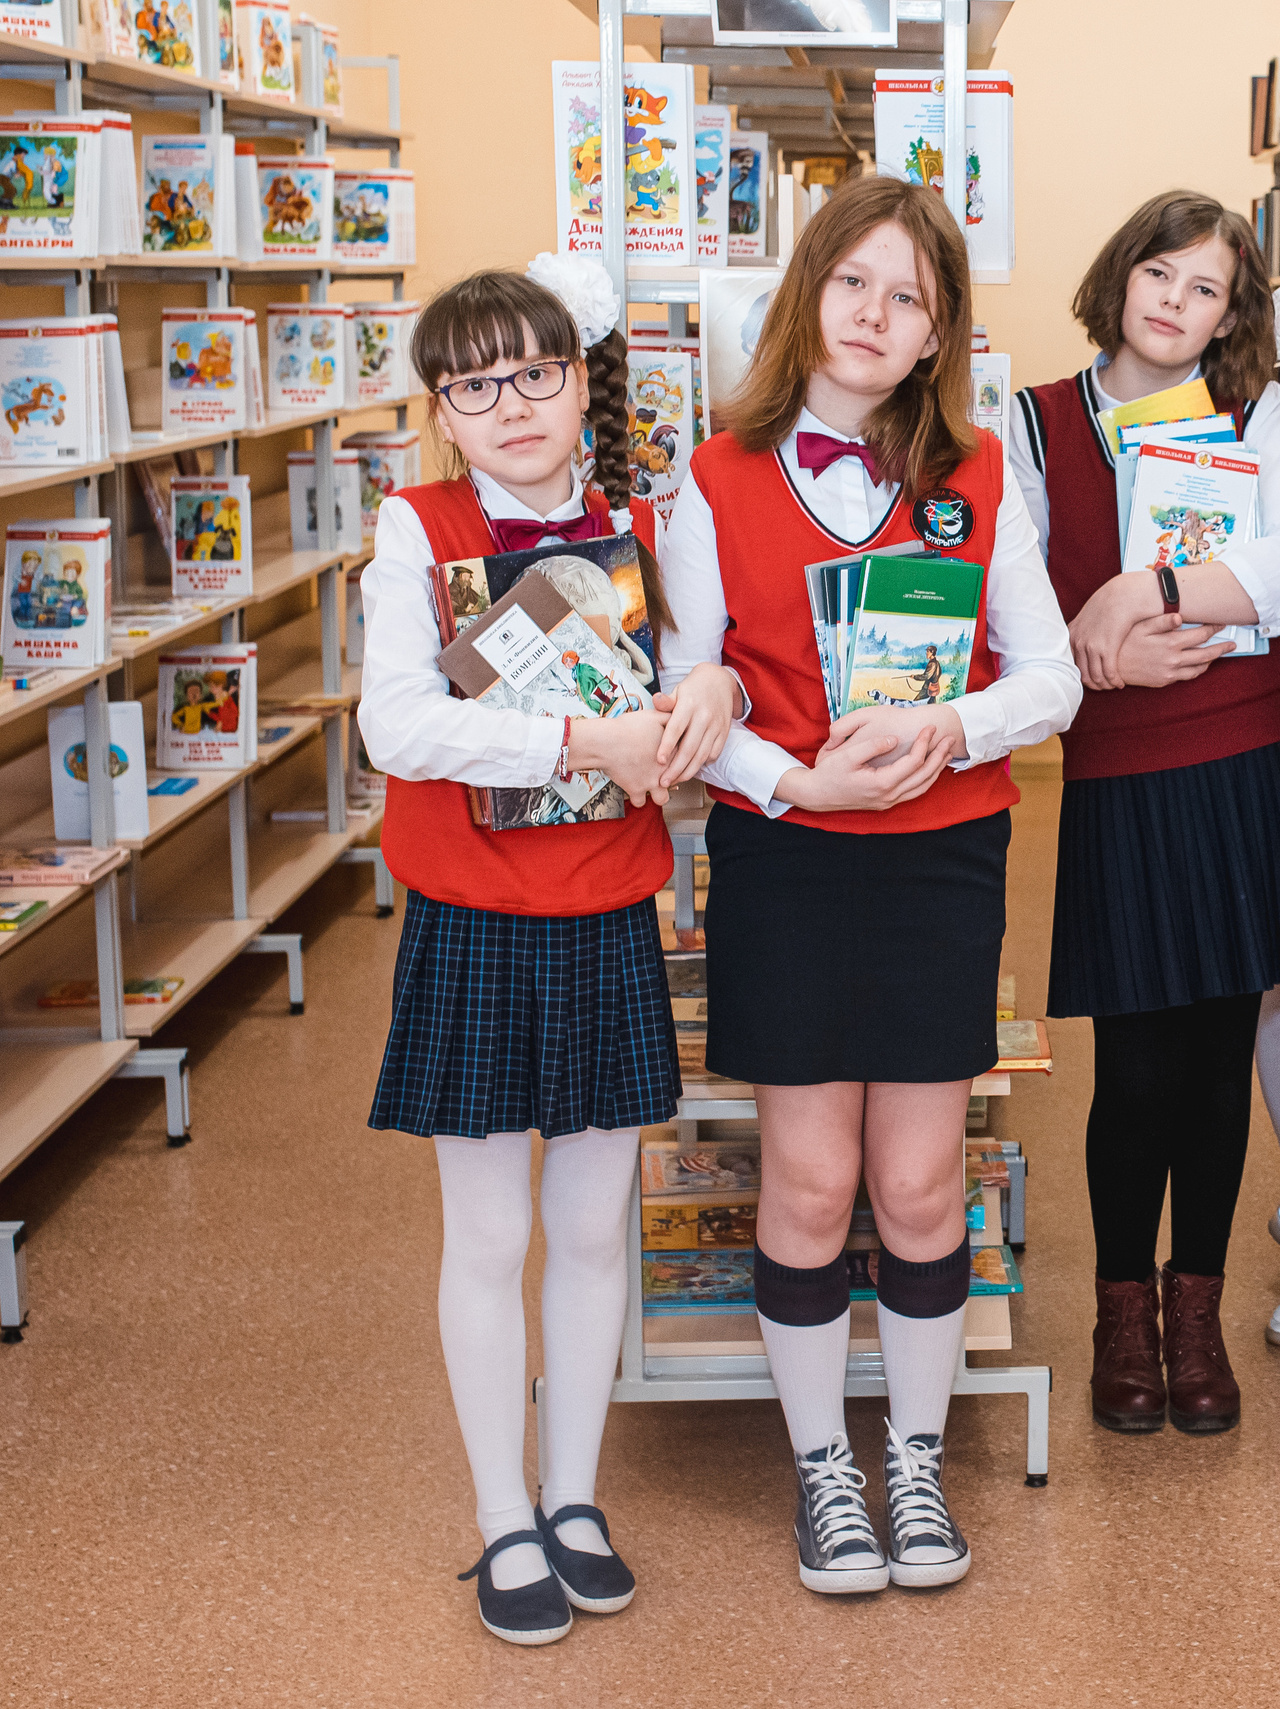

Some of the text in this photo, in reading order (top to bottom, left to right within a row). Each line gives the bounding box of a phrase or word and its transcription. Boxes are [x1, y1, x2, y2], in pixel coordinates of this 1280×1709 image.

[1, 16, 51, 28] ИШКИНА
[888, 82, 928, 90] ШКОЛЬНАЯ
[0, 237, 74, 248] АНТАЗЁРЫ
[1155, 448, 1256, 472] ШКОЛЬНАЯ БИБЛИОТЕКА
[510, 643, 549, 681] КОМЕДИИ
